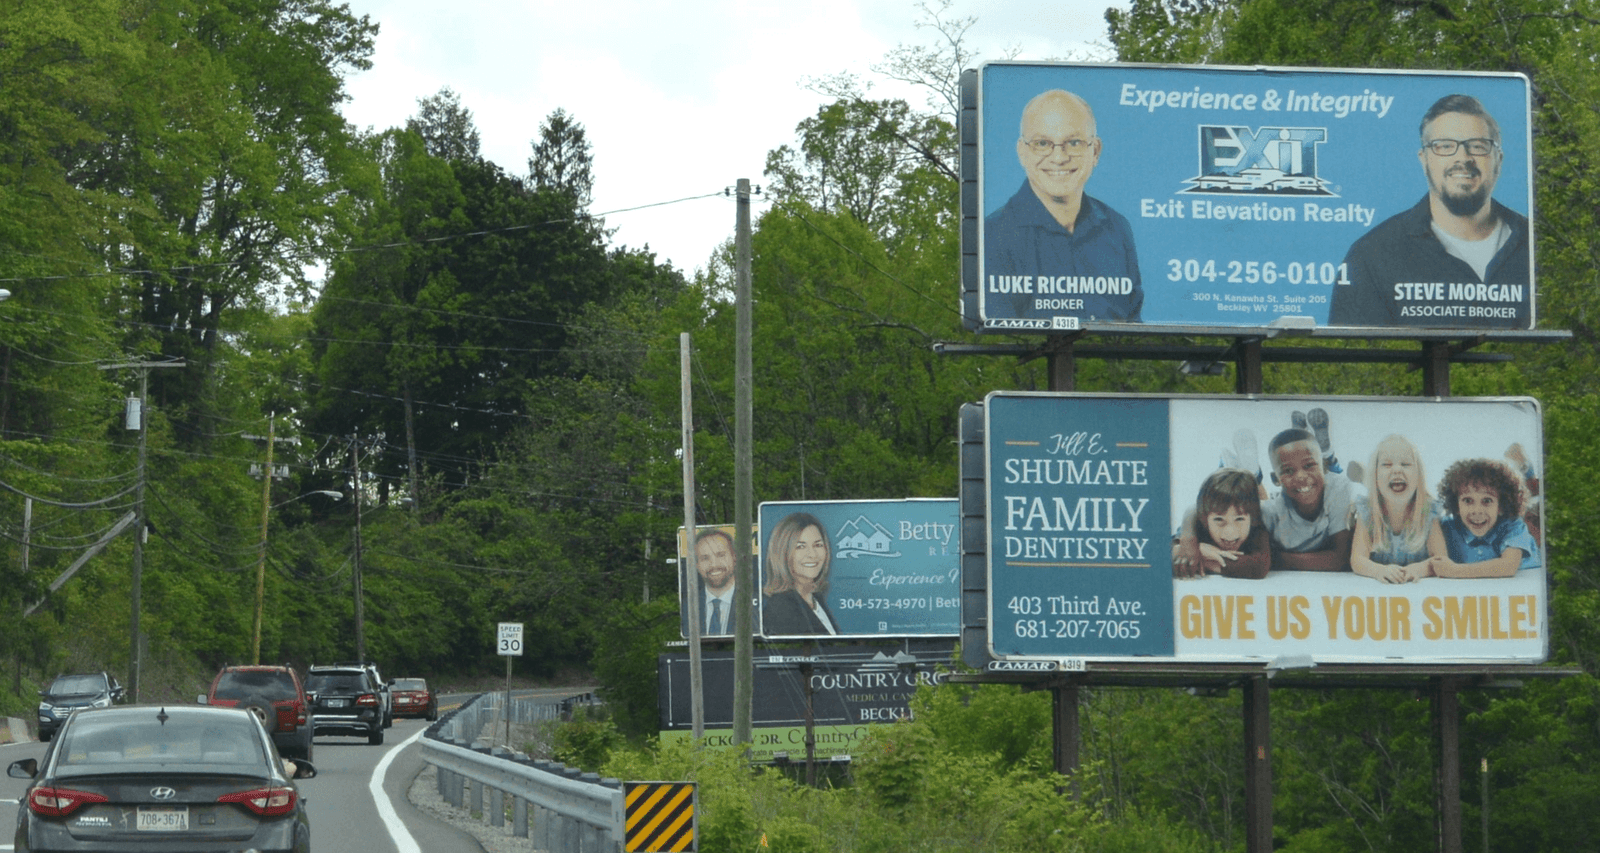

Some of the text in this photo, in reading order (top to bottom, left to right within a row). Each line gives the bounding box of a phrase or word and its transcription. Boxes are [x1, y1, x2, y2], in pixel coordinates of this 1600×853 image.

[1119, 83, 1395, 119] Experience & Integrity
[1140, 198, 1376, 227] Exit Elevation Realty
[1167, 258, 1351, 286] 304-256-0101
[989, 275, 1133, 295] LUKE RICHMOND
[1394, 283, 1523, 302] STEVE MORGAN
[1035, 299, 1084, 310] BROKER
[1192, 292, 1211, 301] 300
[1224, 294, 1265, 303] Kanawha
[1266, 295, 1279, 303] St.
[1283, 295, 1306, 303] Suite
[1308, 295, 1327, 304] 205
[1253, 304, 1268, 313] WV
[1273, 304, 1303, 313] 25801
[1400, 306, 1517, 318] ASSOCIATE BROKER
[989, 319, 1046, 328] LAMAR
[1056, 318, 1075, 329] 4318
[1046, 432, 1108, 456] Jill E.
[1004, 458, 1149, 485] SHUMATE
[1004, 496, 1150, 532] FAMILY
[899, 520, 955, 546] Betty
[1004, 536, 1150, 560] DENTISTRY
[869, 568, 945, 591] Experience
[839, 598, 926, 610] 304-573-4970
[1008, 595, 1146, 616] 403 Third Ave.
[1180, 594, 1538, 641] GIVE US YOUR SMILE!
[1015, 619, 1141, 639] 681-207-7065
[500, 639, 520, 651] 30
[994, 660, 1050, 670] LAMAR
[1062, 660, 1081, 670] 4319
[811, 672, 901, 690] COUNTRY
[846, 693, 889, 703] MEDICAL
